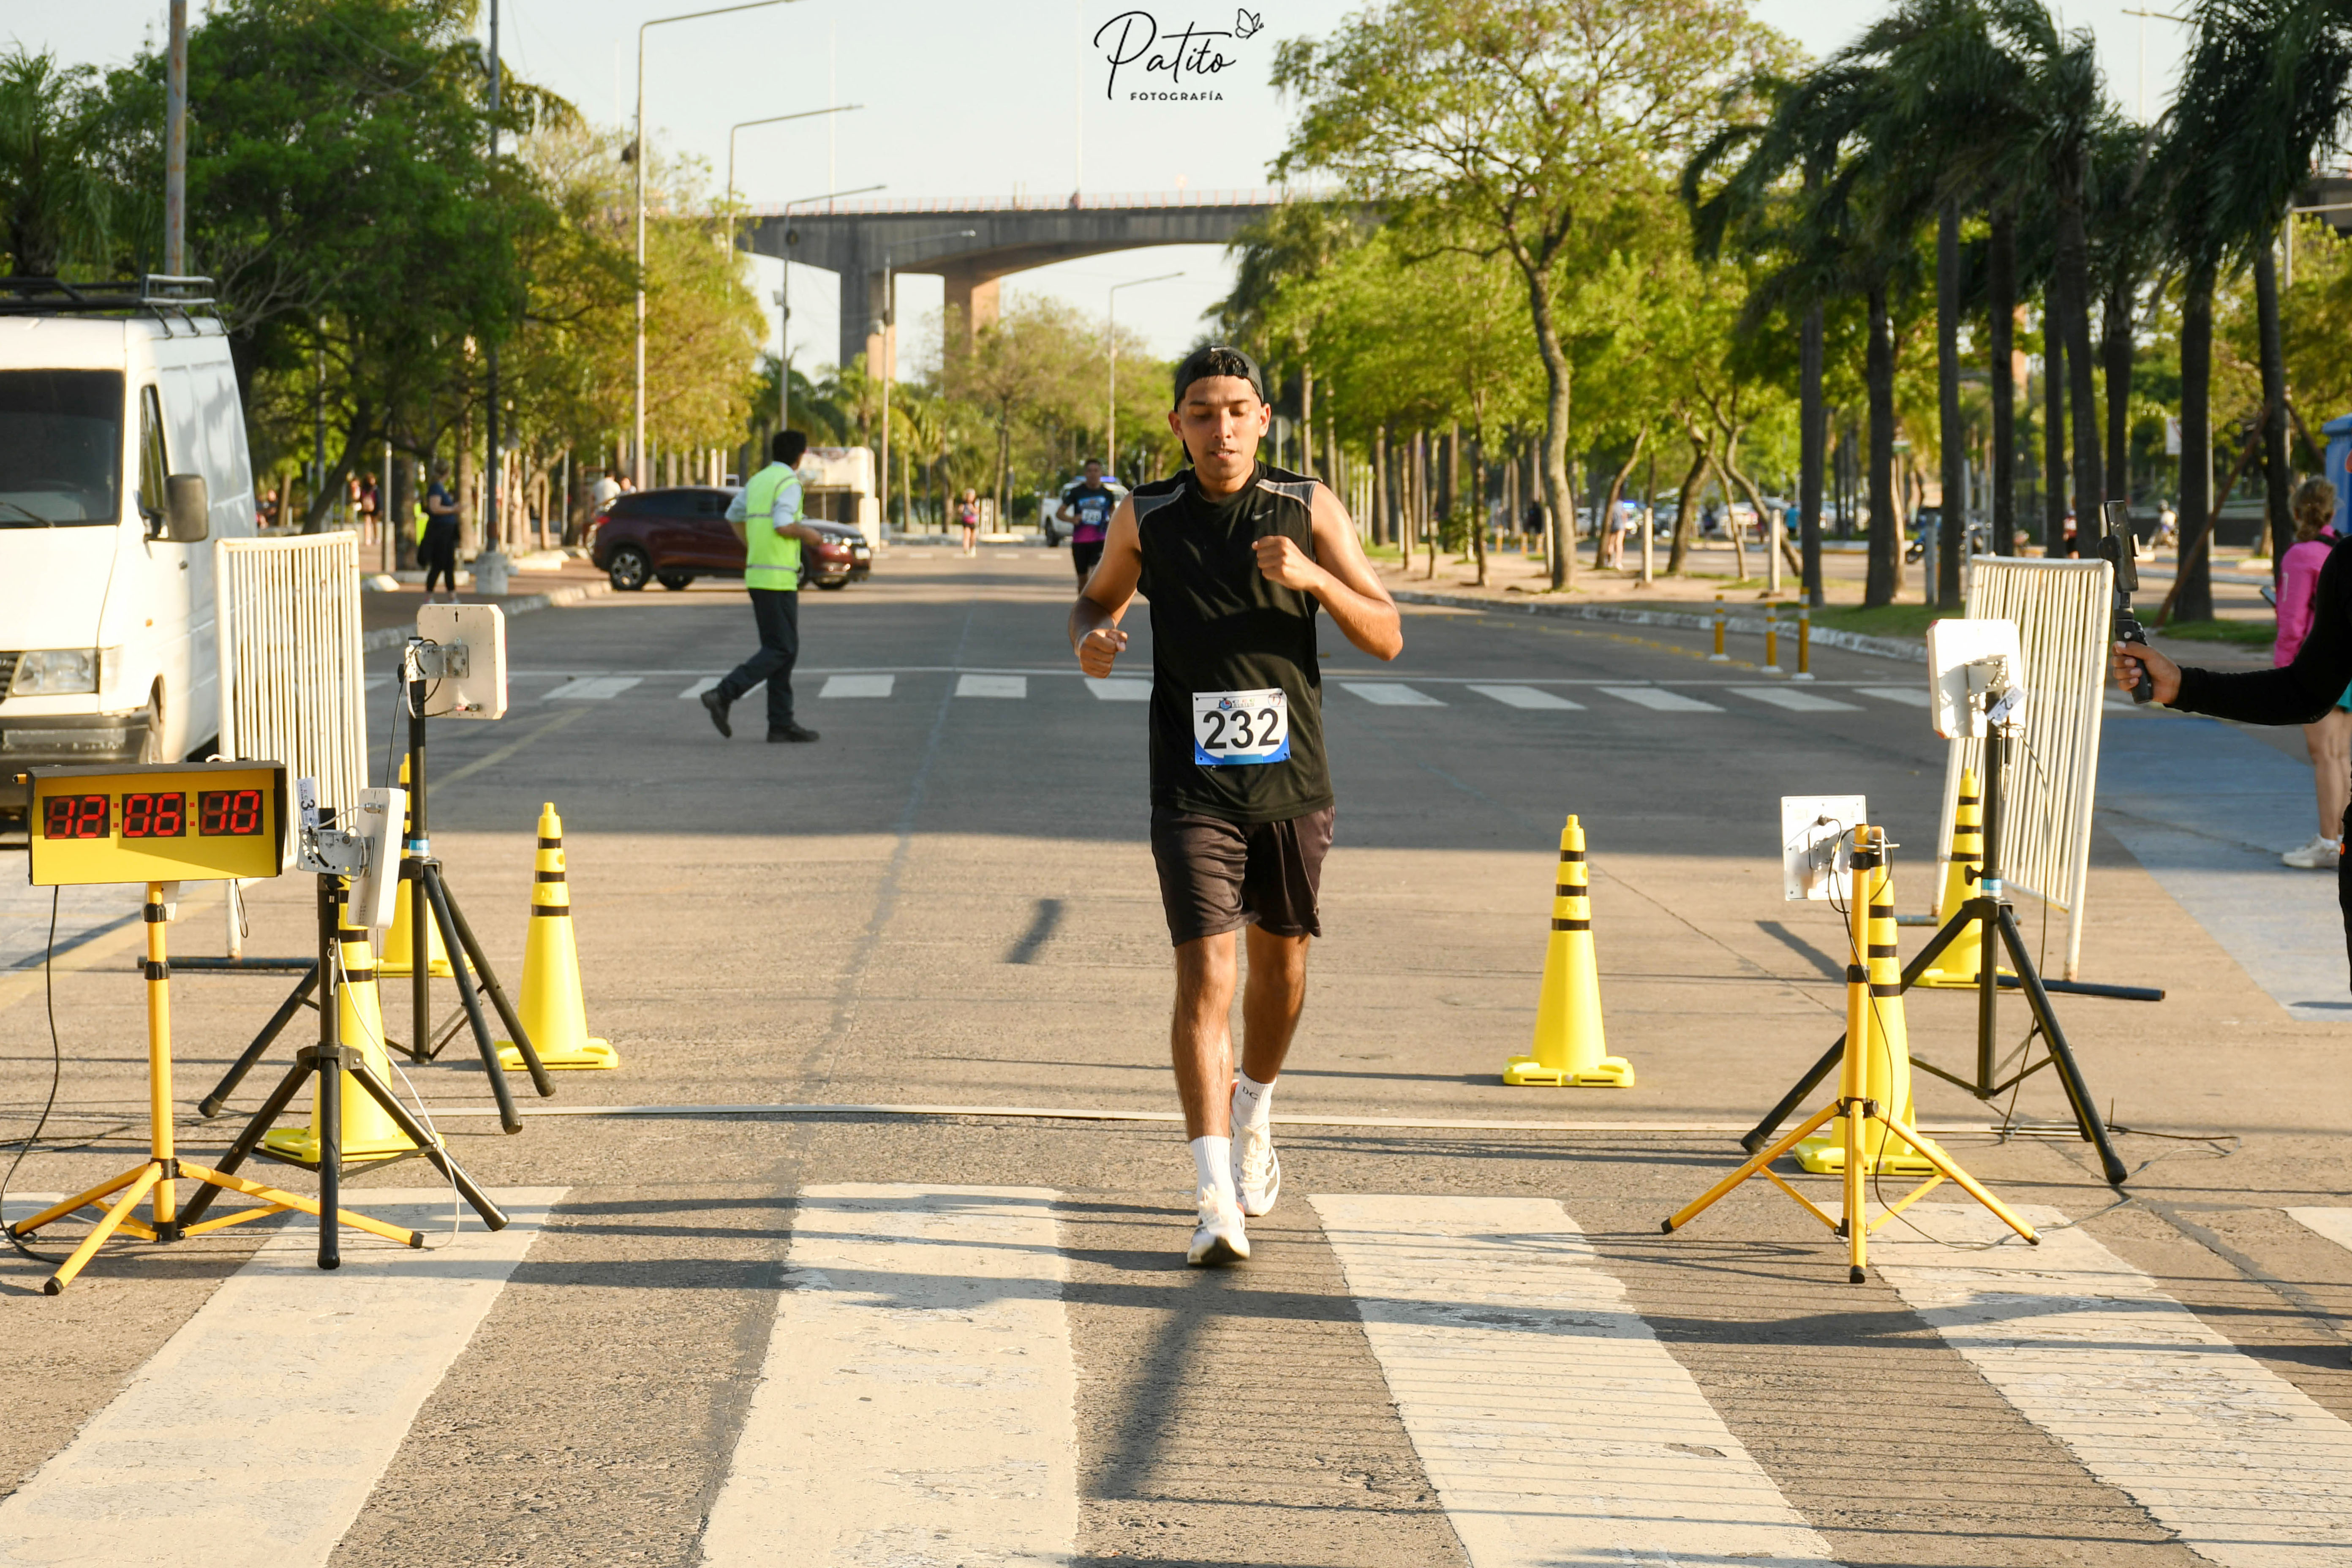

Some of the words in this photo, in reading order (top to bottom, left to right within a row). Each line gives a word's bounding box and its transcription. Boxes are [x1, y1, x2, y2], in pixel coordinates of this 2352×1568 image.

[2000, 698, 2013, 710] 2
[1203, 708, 1279, 749] 232
[301, 799, 315, 810] 3
